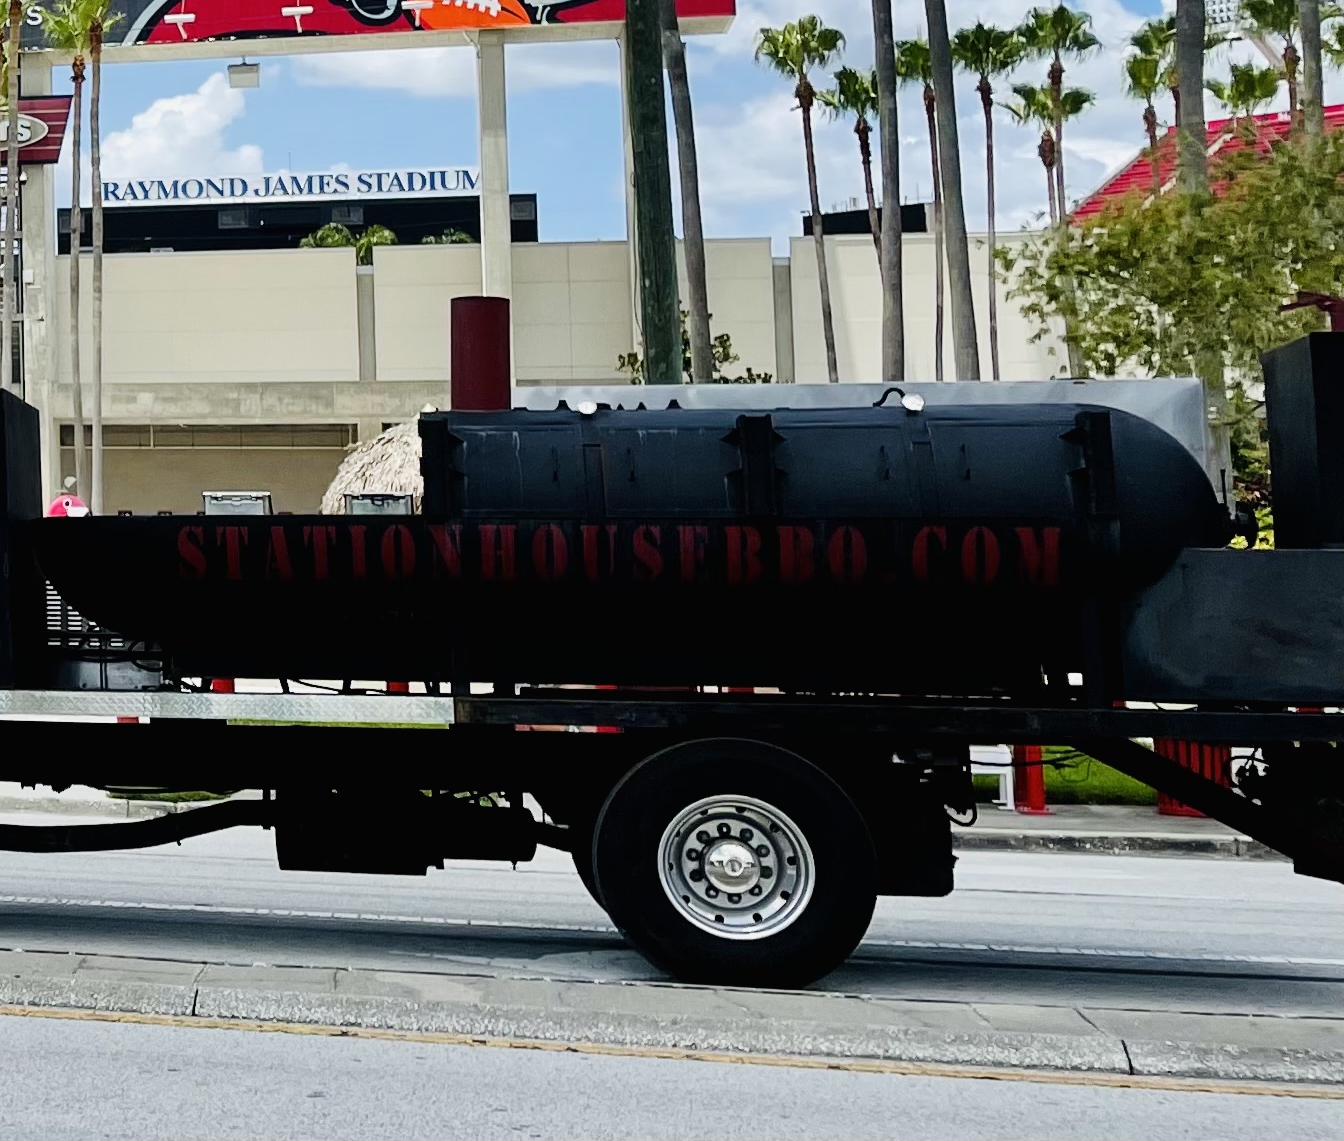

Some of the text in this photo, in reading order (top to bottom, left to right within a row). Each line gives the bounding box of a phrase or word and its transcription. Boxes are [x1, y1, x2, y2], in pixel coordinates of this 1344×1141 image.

[102, 170, 481, 201] RAYMOND JAMES STADIUM
